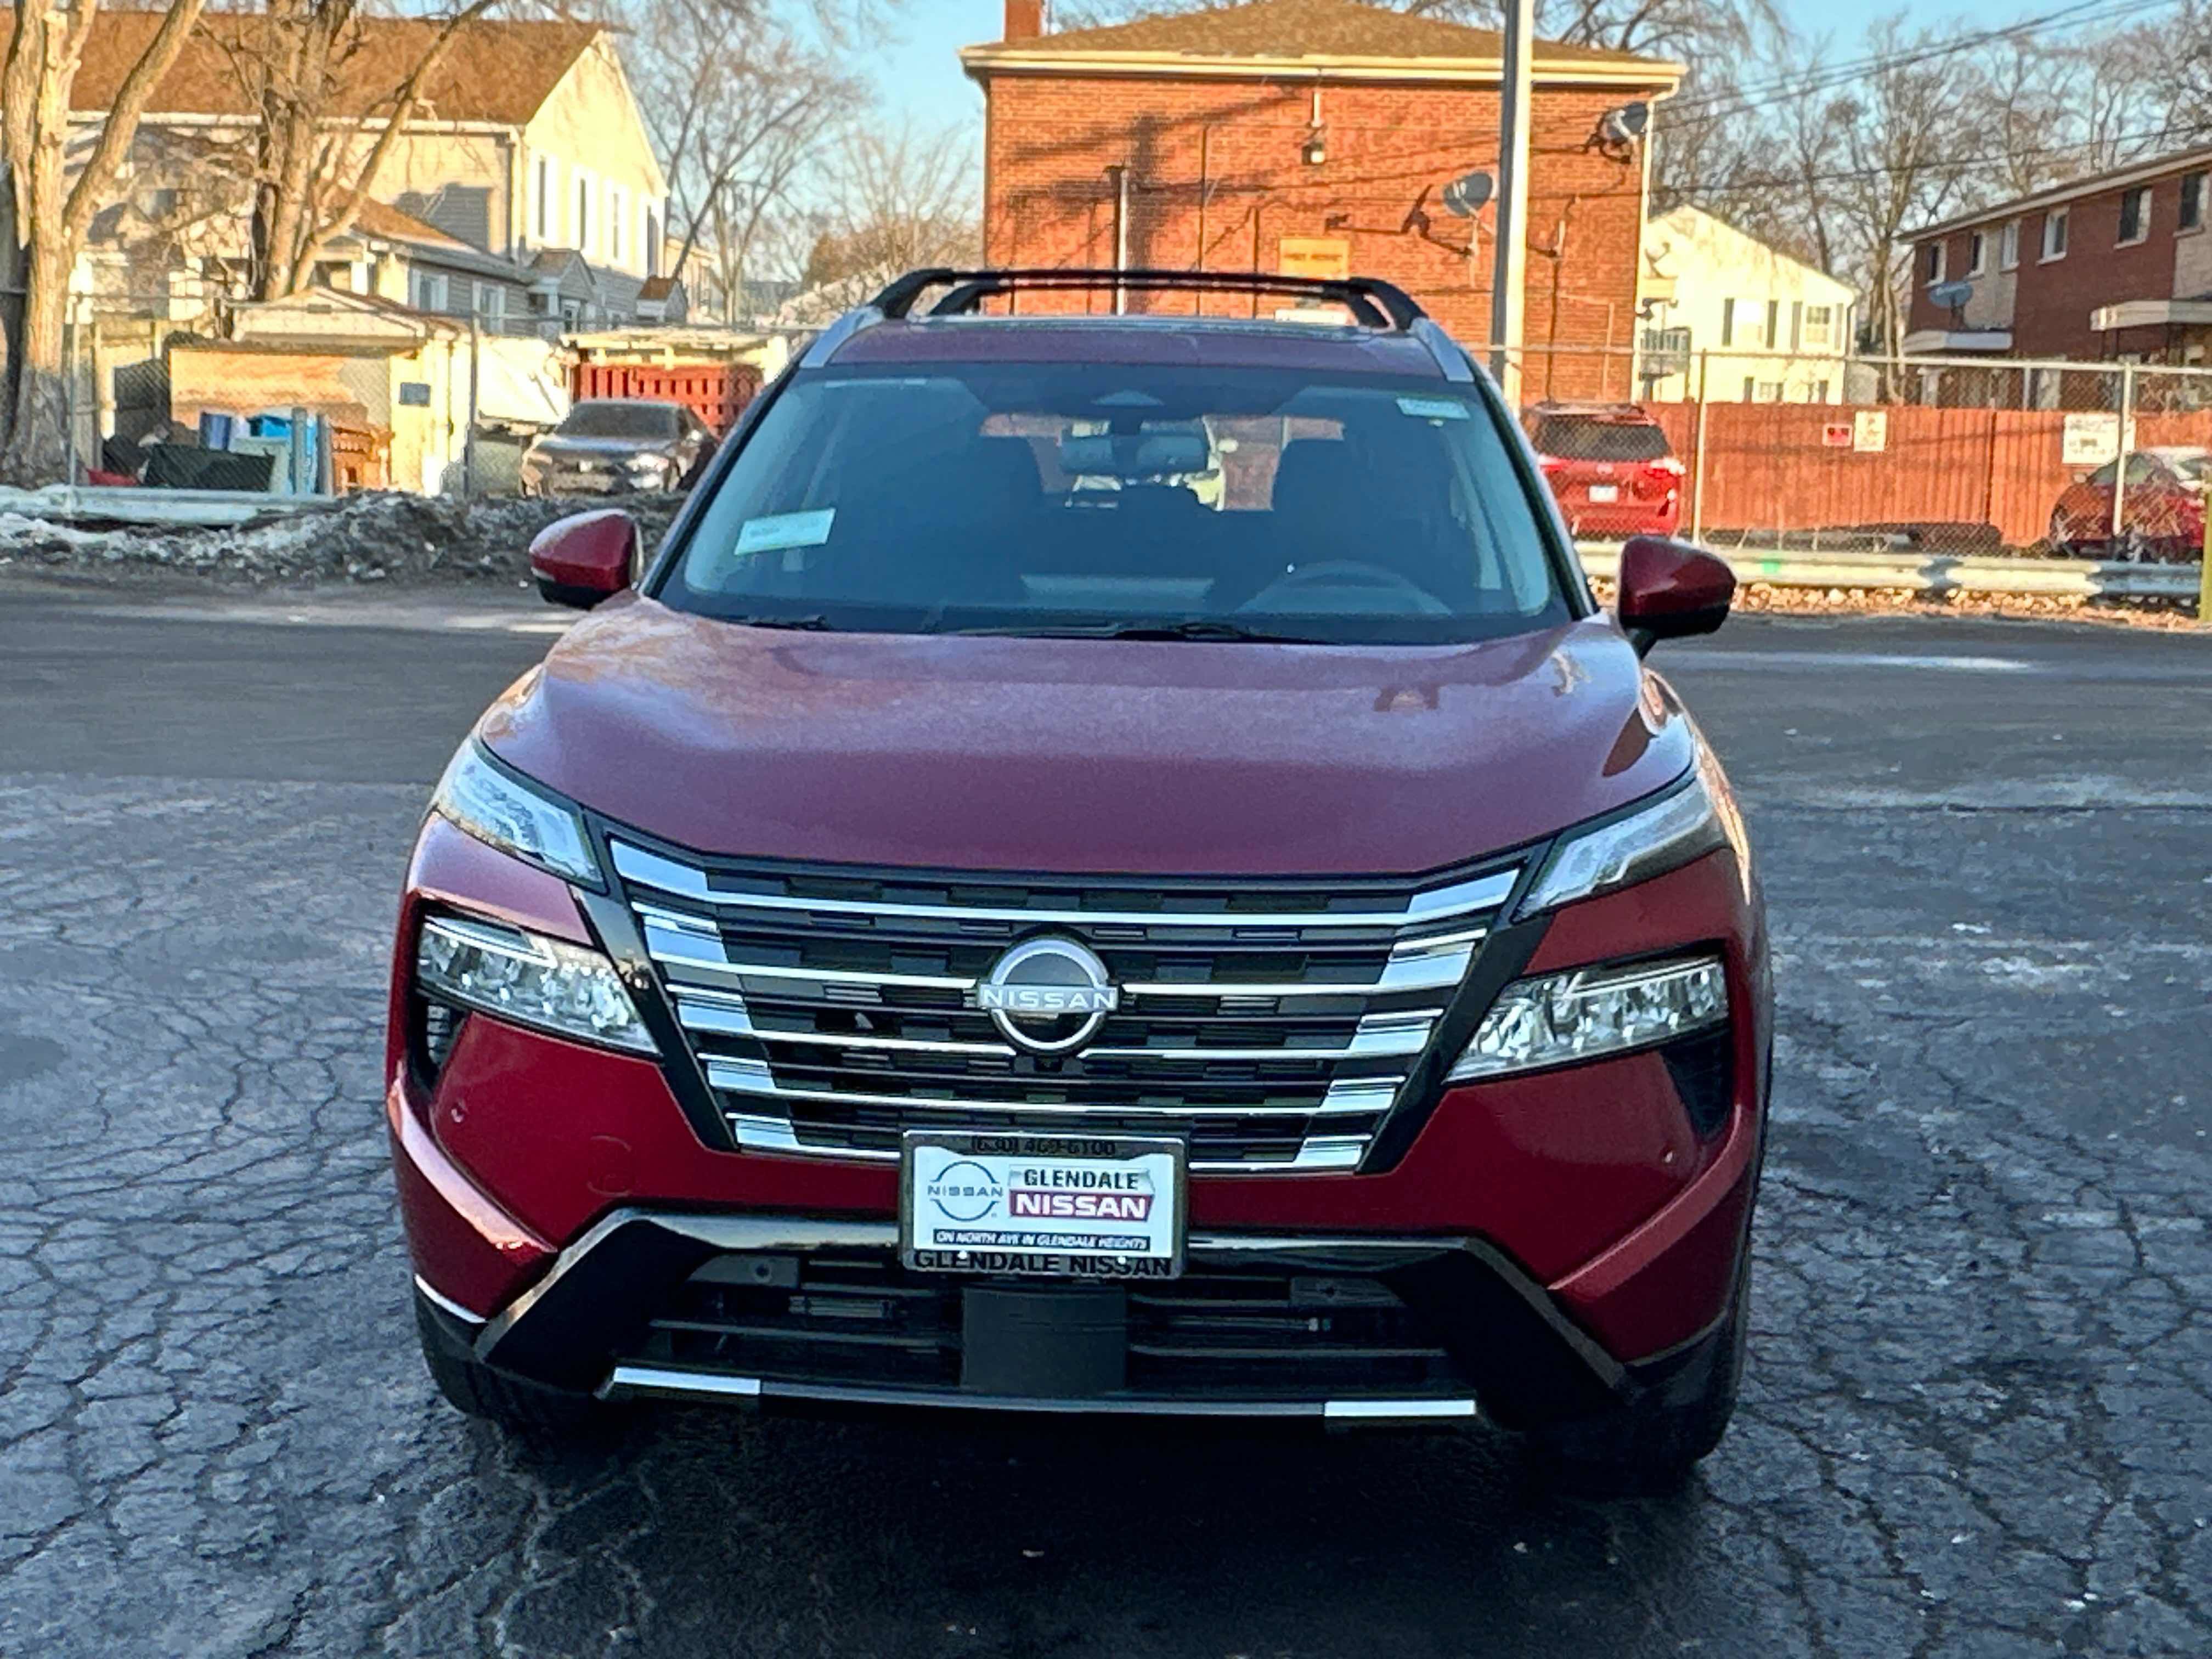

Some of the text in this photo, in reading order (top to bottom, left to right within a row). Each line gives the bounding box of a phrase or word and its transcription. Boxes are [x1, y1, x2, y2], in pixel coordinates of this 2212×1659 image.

[983, 989, 1114, 1008] NISSAN
[1024, 1169, 1139, 1189] GLENDALE
[927, 1185, 1003, 1197] NISSAN
[1015, 1193, 1146, 1218] NISSAN
[936, 1231, 955, 1243] ON
[956, 1232, 997, 1244] NORTH
[1021, 1234, 1036, 1245] IN
[1036, 1234, 1097, 1248] GLENDALE
[1098, 1237, 1148, 1250] HEIGHTS
[914, 1250, 1172, 1276] GLENDALE NISSAN
